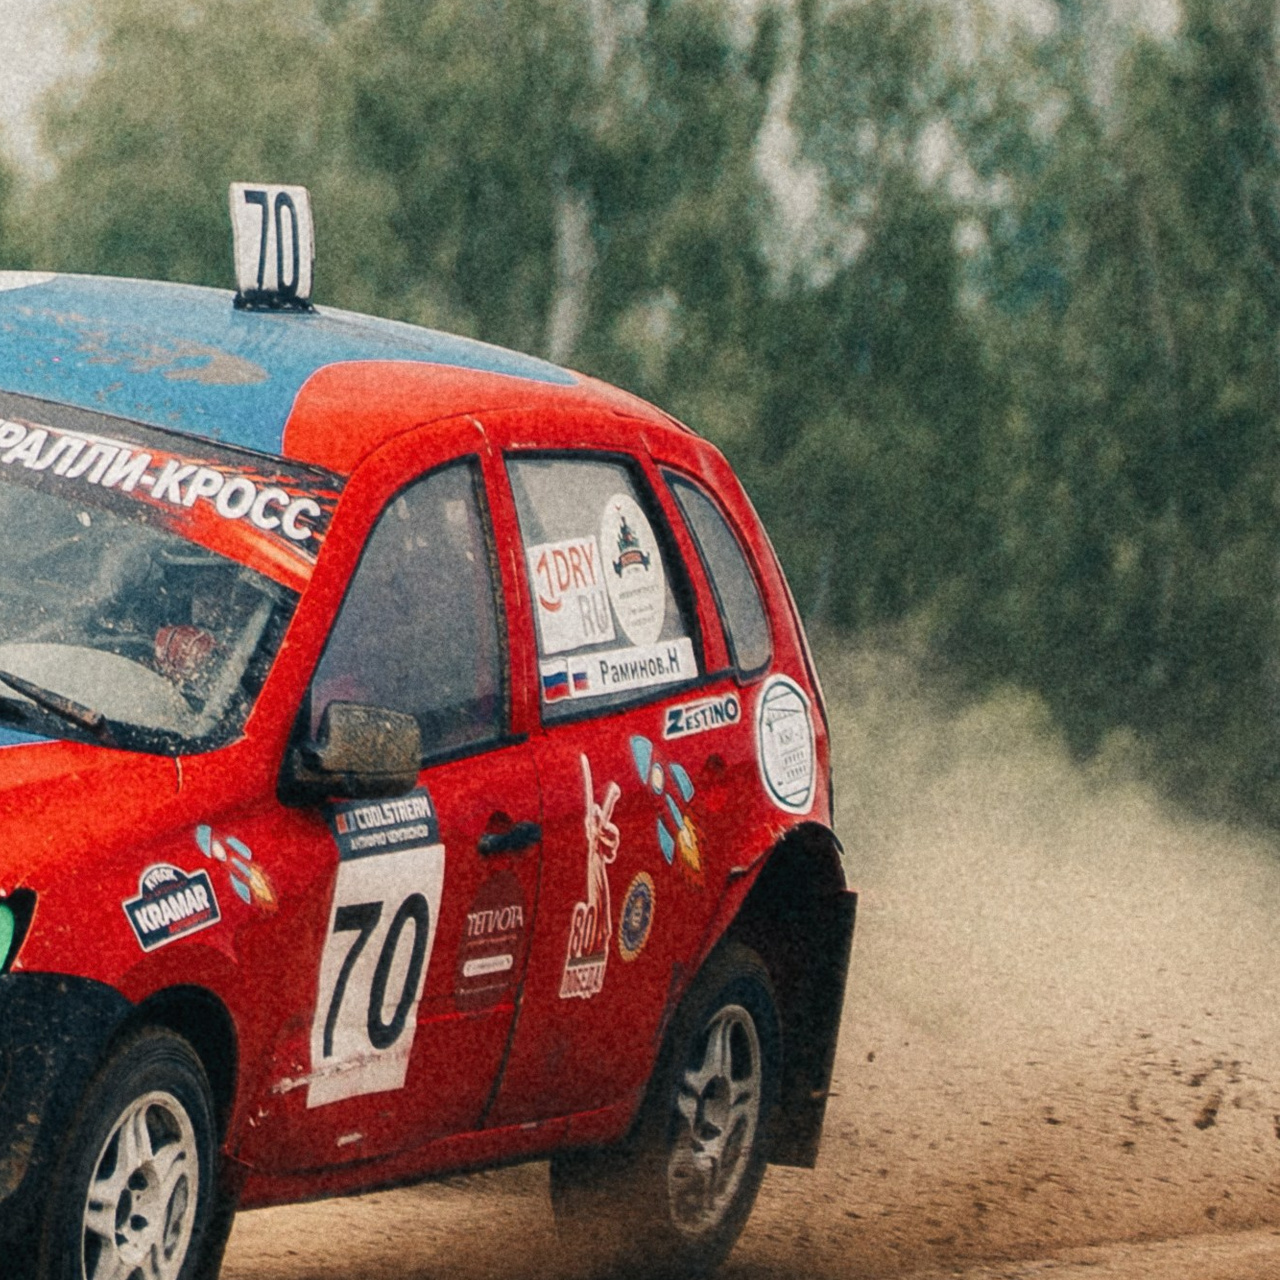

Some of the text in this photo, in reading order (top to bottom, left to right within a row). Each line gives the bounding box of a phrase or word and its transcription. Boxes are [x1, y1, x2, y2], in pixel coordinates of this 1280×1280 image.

[243, 189, 300, 294] 70
[666, 697, 738, 736] ZESTINO
[354, 796, 432, 830] COOLSTREAM
[134, 884, 211, 934] KRAMAR
[322, 892, 430, 1059] 70
